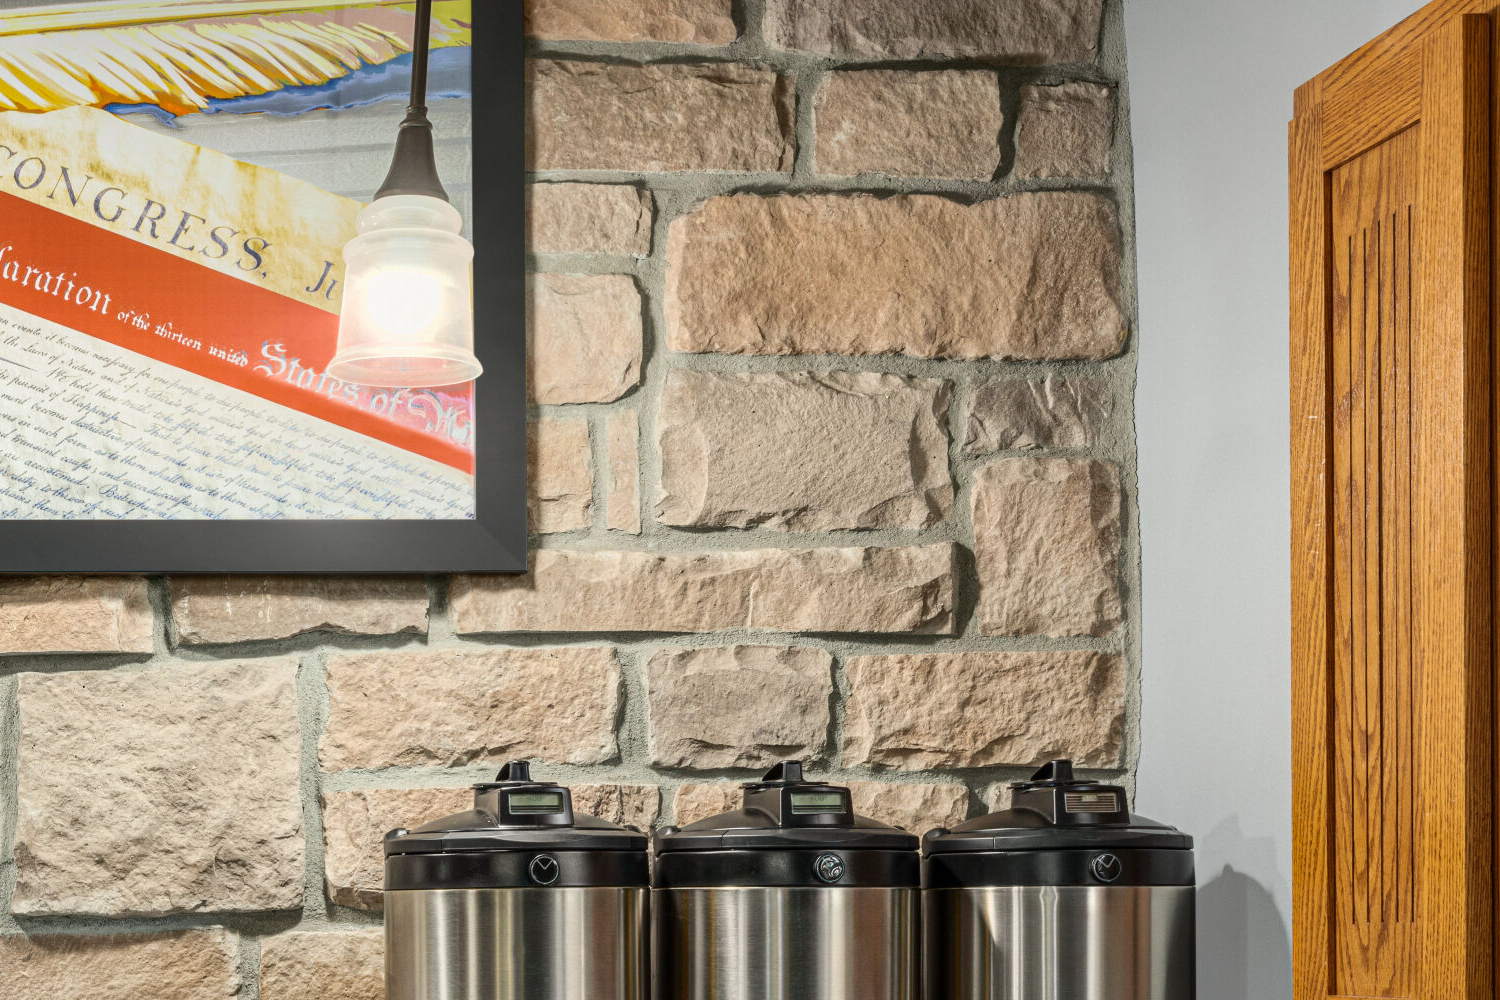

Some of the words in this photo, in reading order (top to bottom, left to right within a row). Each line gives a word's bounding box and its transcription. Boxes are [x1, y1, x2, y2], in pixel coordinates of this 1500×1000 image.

[56, 336, 88, 353] becomes
[155, 321, 203, 351] thirteen
[208, 345, 248, 367] united
[253, 341, 360, 407] States
[31, 400, 67, 420] becomes
